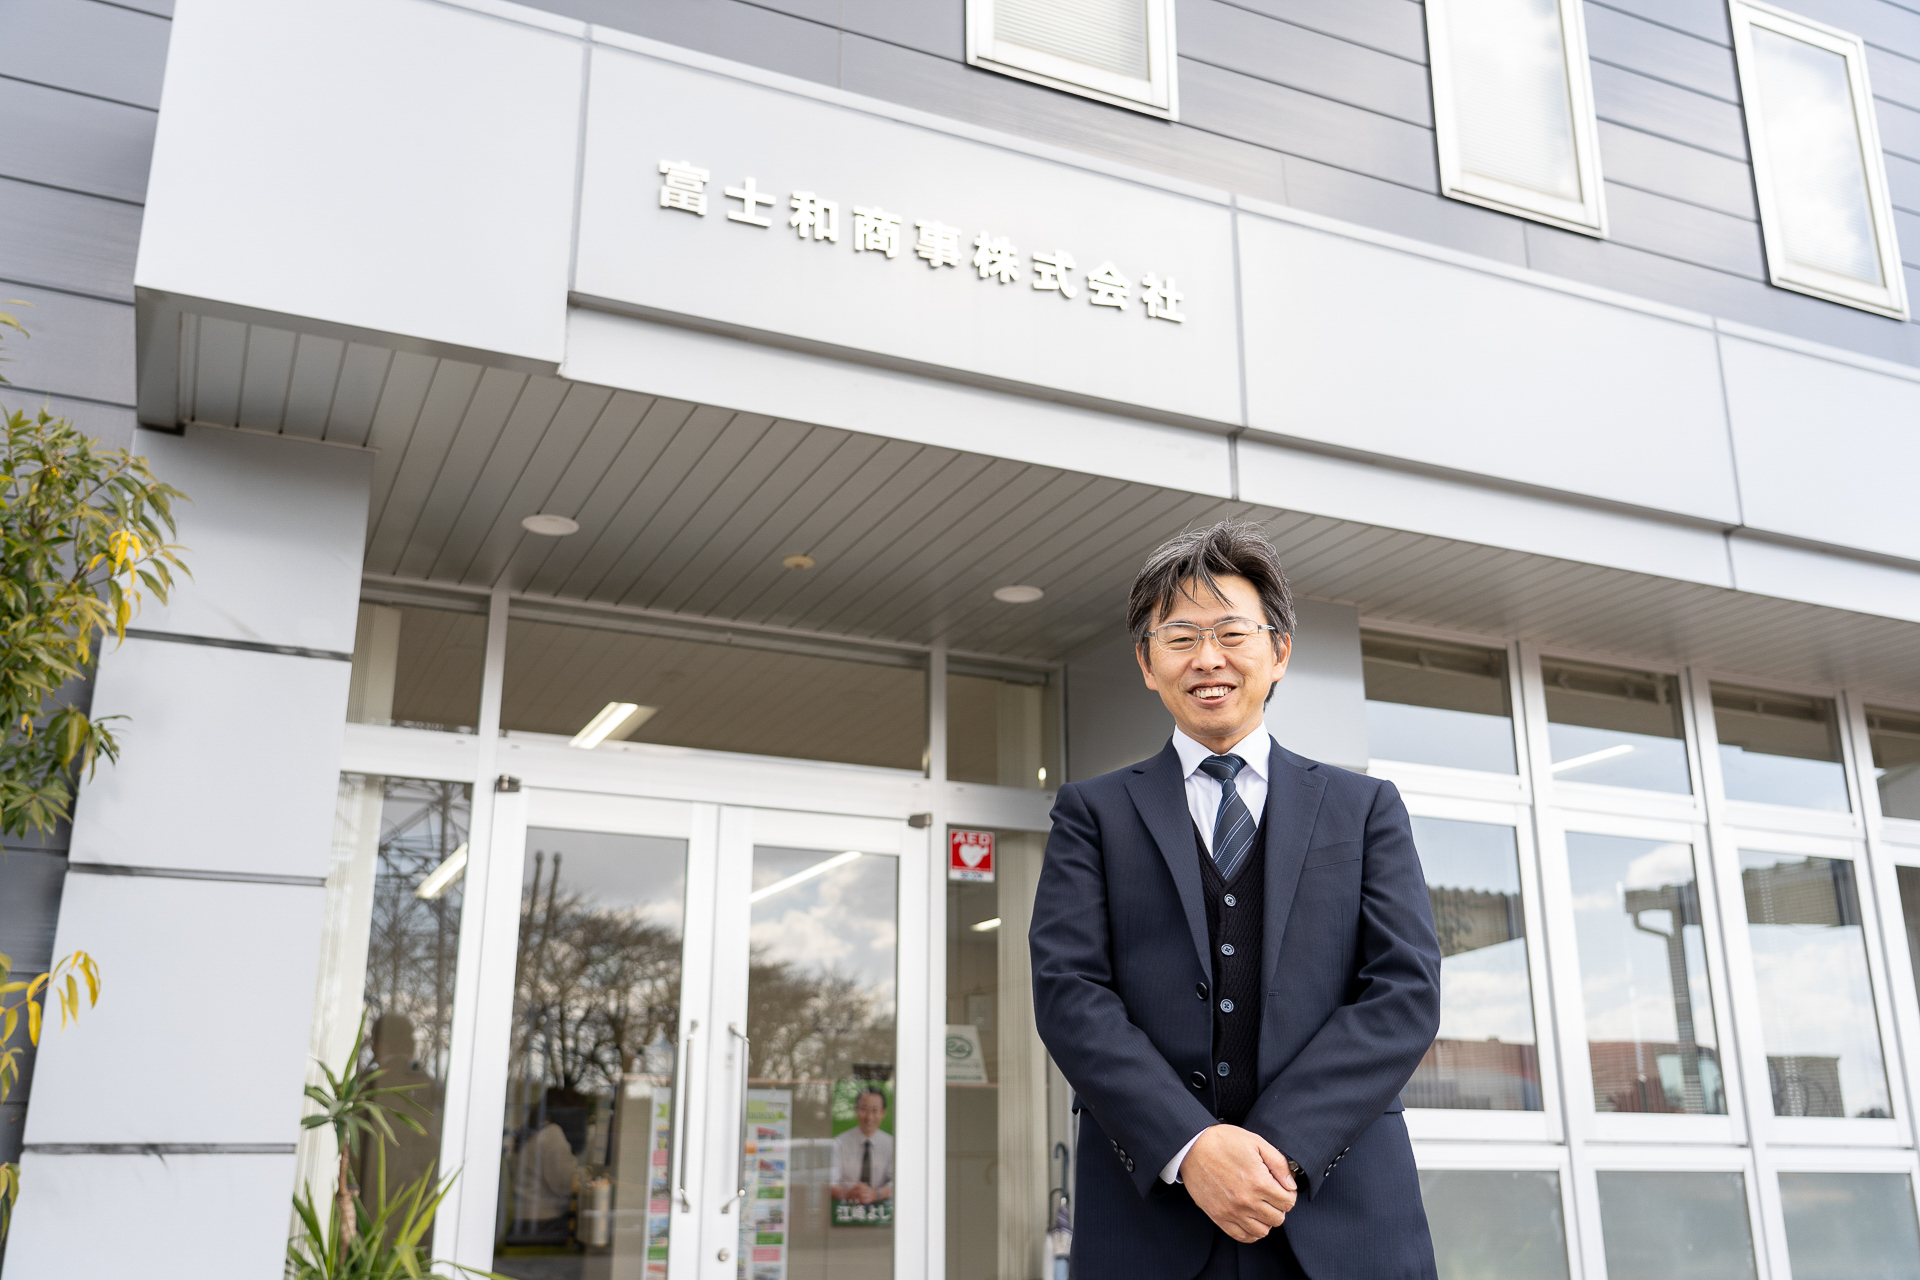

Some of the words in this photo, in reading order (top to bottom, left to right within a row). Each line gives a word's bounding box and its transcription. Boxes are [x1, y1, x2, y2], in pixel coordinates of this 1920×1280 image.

[658, 159, 1187, 323] 富士和商事株式会社
[953, 832, 990, 846] AED
